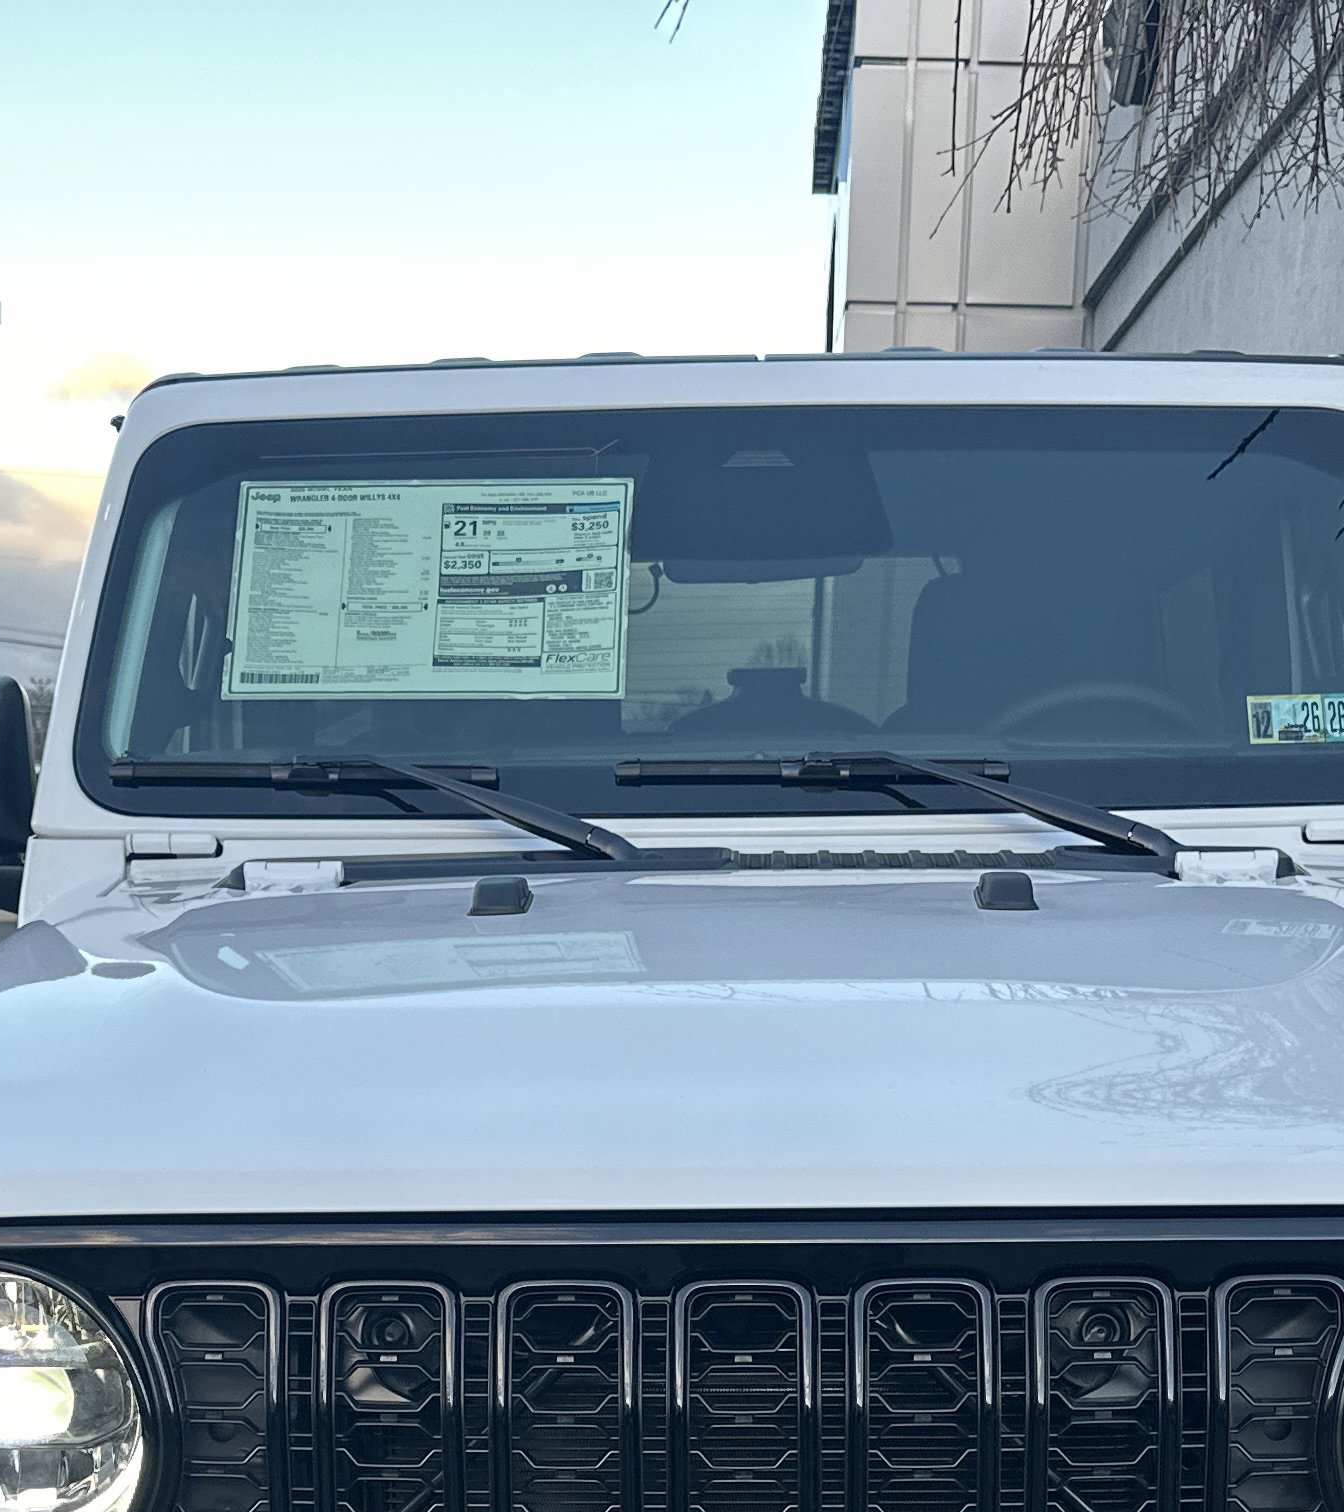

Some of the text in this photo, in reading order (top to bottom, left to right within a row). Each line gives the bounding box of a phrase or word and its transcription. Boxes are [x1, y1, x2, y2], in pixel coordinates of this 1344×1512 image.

[250, 491, 282, 503] Jeep
[290, 494, 330, 503] WRANGLER
[359, 493, 386, 502] WILLYS
[582, 513, 608, 521] spend
[453, 520, 478, 537] 21
[571, 520, 609, 532] $3,250
[443, 560, 482, 570] $2,350
[545, 652, 611, 664] FlexCare
[1252, 710, 1274, 739] 12
[1301, 701, 1321, 733] 26
